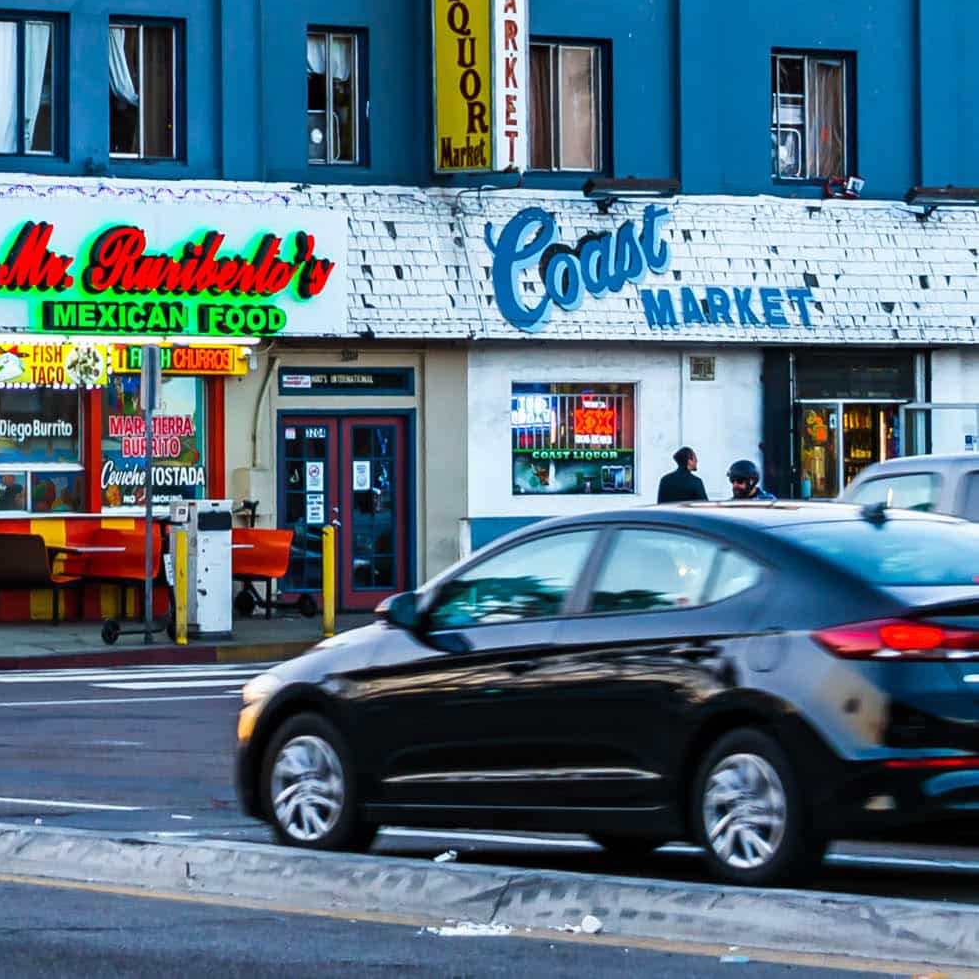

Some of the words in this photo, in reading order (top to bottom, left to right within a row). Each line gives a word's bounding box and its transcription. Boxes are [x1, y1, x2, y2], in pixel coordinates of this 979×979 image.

[440, 136, 487, 169] Market
[484, 204, 671, 333] Coast
[45, 302, 190, 331] MEXICAN
[204, 304, 287, 332] FOOD
[641, 286, 814, 330] MARKET
[32, 345, 63, 363] FISH
[173, 348, 229, 370] CHURROS
[31, 365, 65, 384] TACO
[0, 419, 33, 442] Diego
[33, 419, 73, 437] Burrito
[152, 416, 194, 436] TIERRA
[532, 451, 570, 459] COAST
[573, 451, 618, 460] LIQUOR
[101, 460, 147, 489] Ceviche
